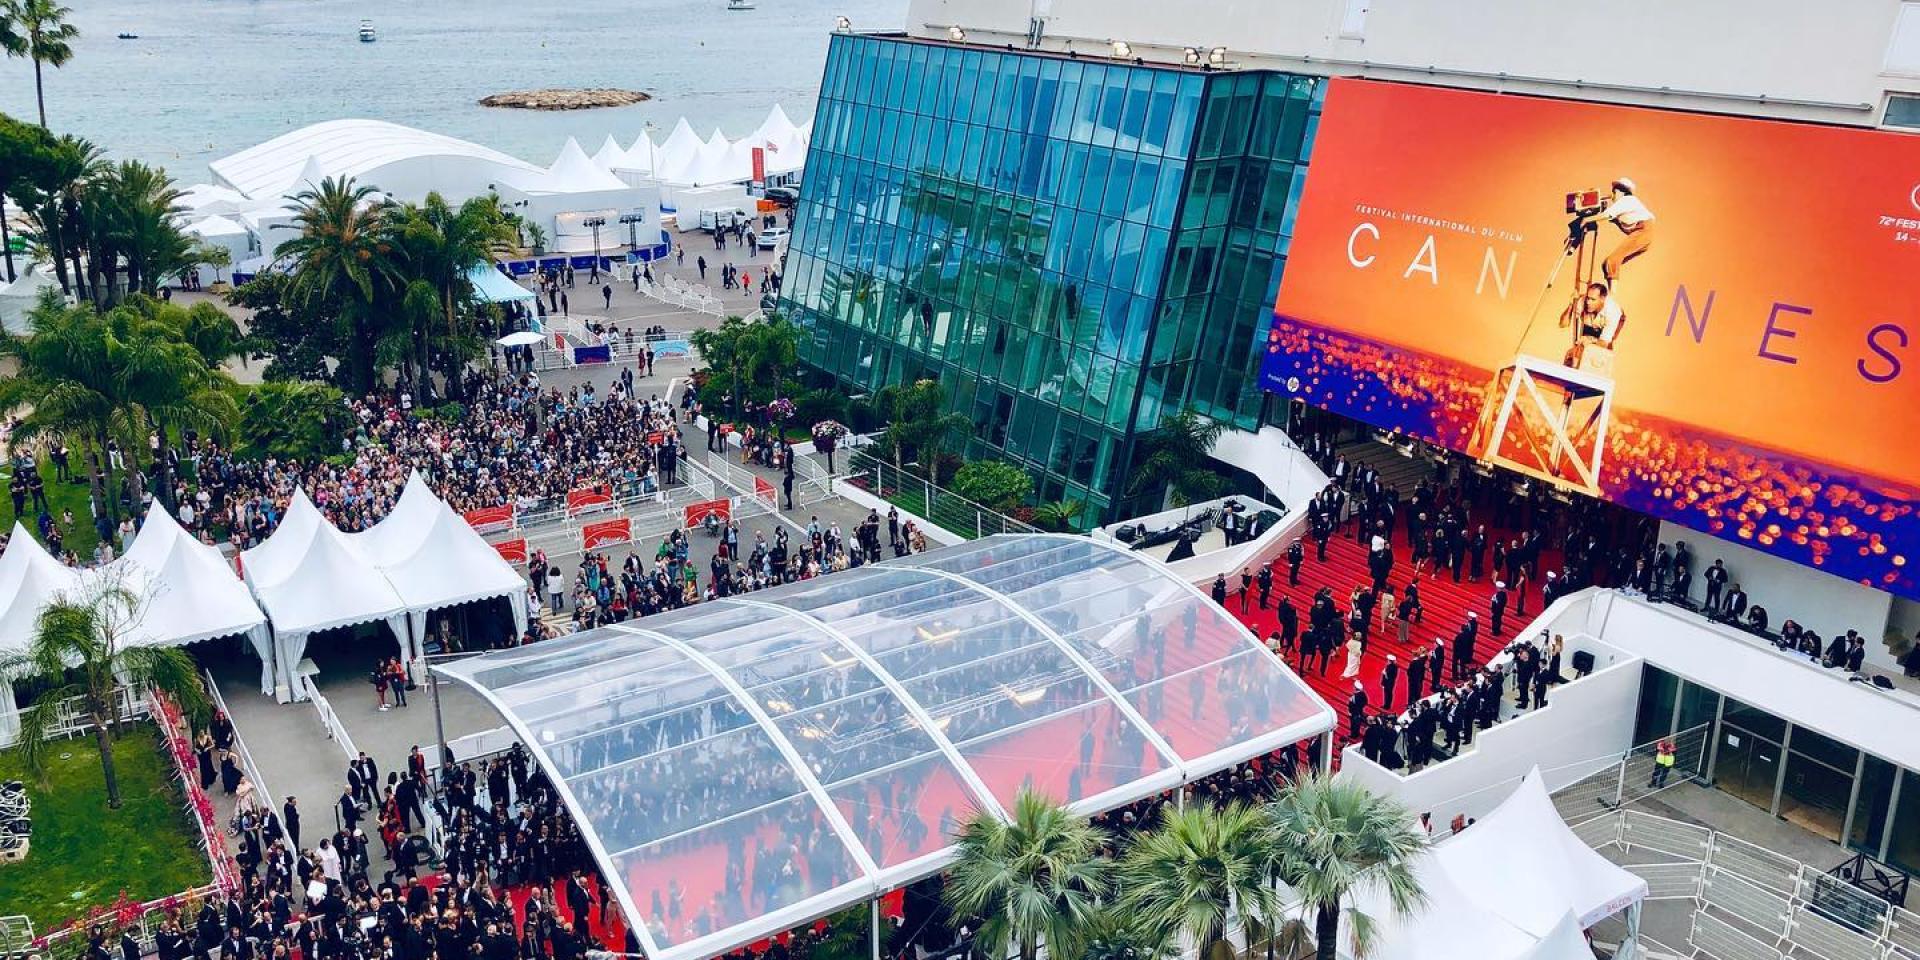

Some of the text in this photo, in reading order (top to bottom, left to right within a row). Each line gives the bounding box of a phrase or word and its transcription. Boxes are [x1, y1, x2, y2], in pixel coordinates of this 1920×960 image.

[1355, 204, 1523, 243] FESTIVAL INTERNATIONAL DU FILM
